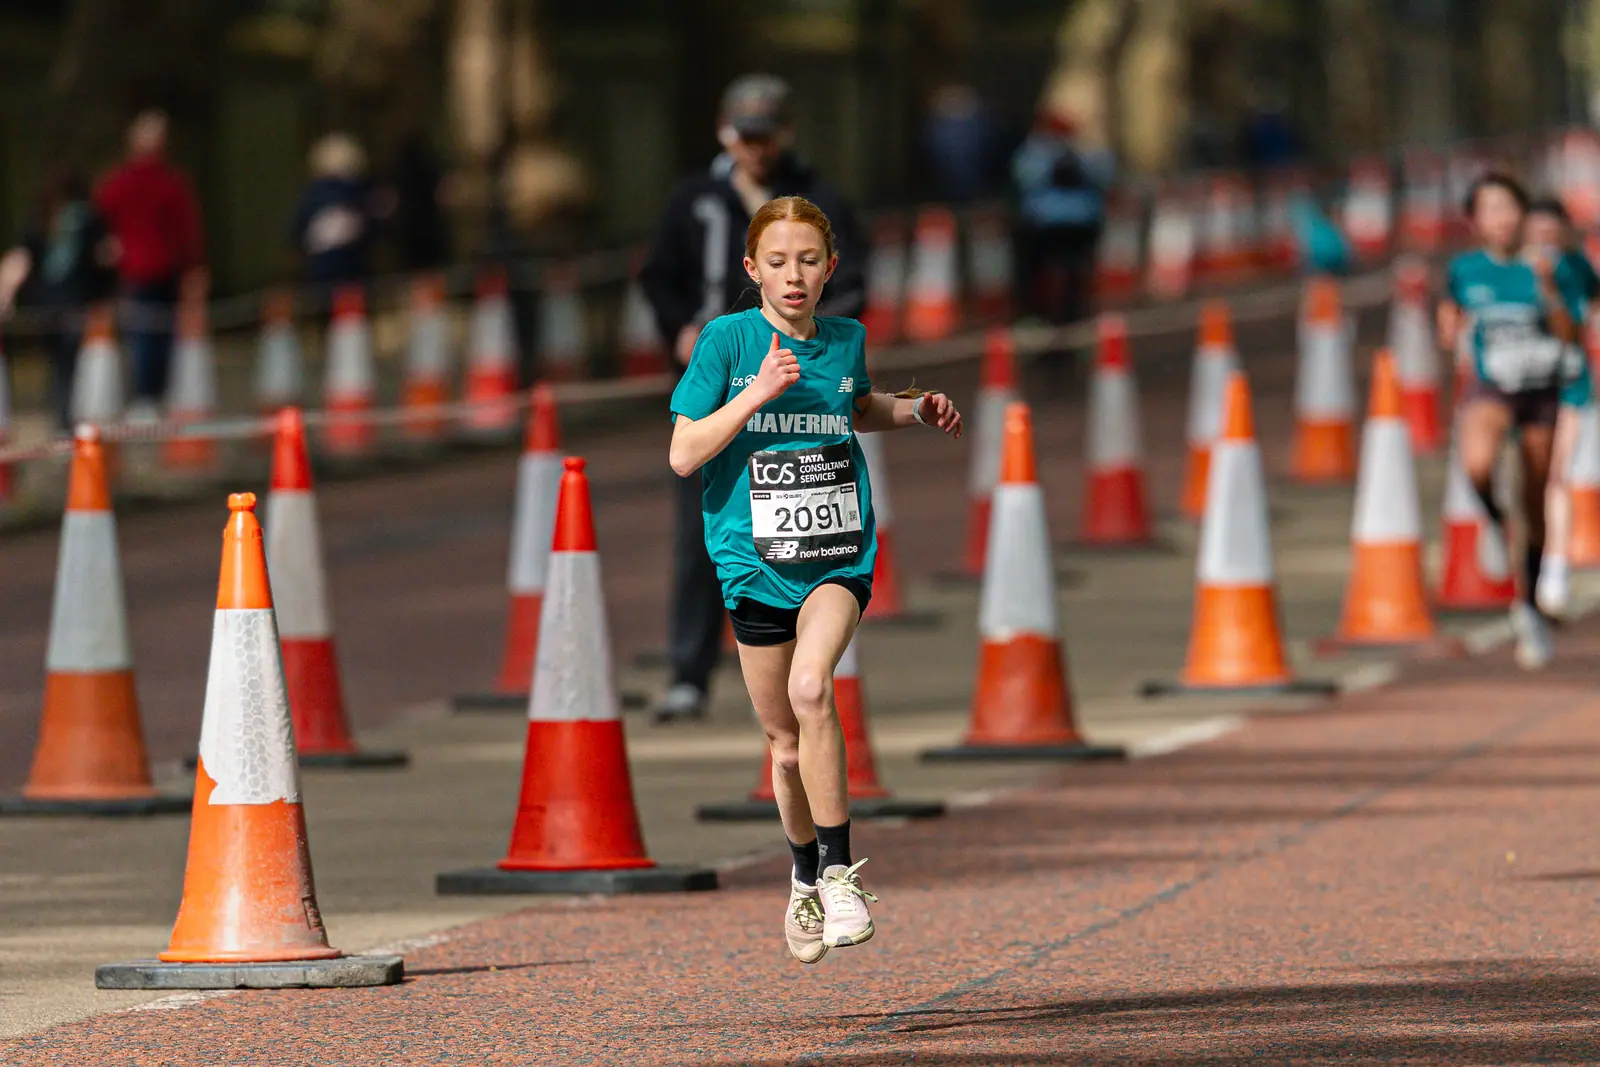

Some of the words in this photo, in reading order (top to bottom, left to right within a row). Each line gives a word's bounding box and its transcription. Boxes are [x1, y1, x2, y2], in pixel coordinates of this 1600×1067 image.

[747, 412, 849, 436] HAVERING
[798, 453, 825, 464] TATA
[752, 457, 796, 485] tcs
[799, 459, 850, 474] CONSULTANCY
[800, 471, 836, 484] SERVICES
[774, 502, 844, 533] 2091
[799, 549, 820, 559] new
[820, 545, 858, 557] balance
